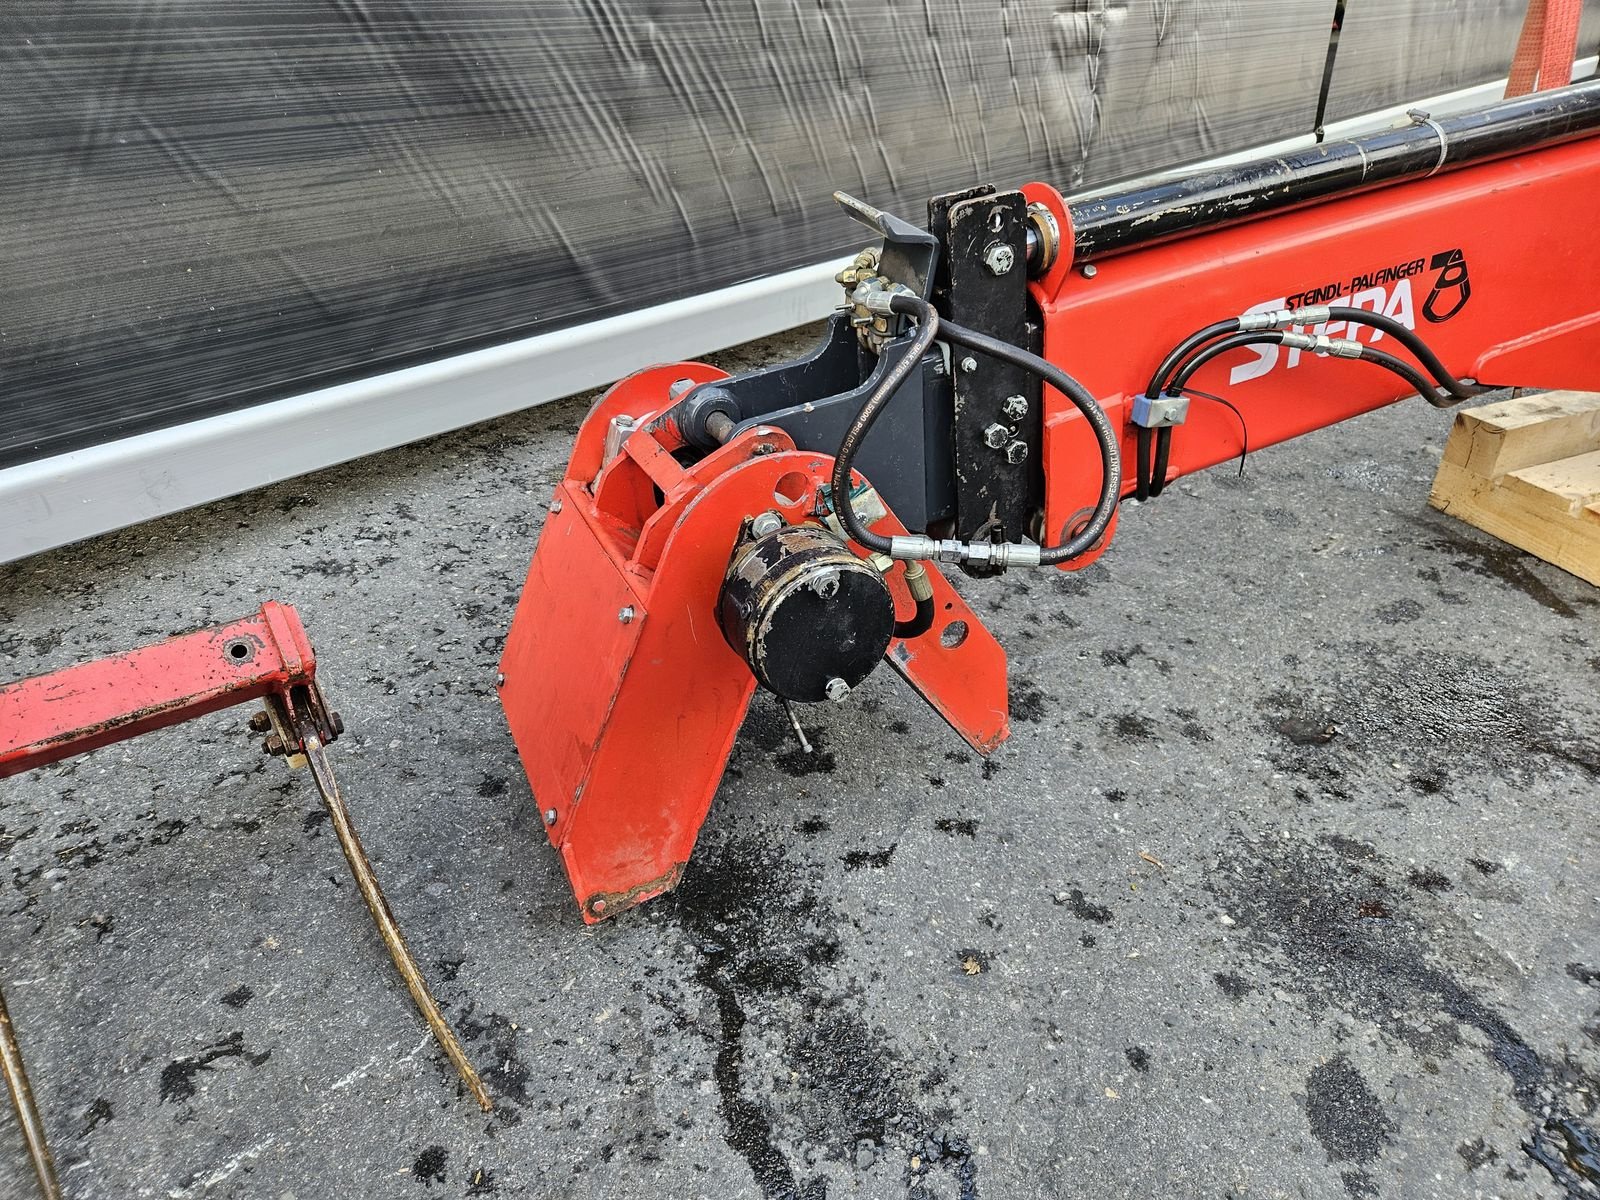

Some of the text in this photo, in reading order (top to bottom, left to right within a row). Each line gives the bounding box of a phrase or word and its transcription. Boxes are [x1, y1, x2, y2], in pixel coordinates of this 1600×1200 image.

[1286, 258, 1425, 311] STEINDL-PALFINGER
[859, 403, 875, 421] 5000
[850, 420, 863, 435] PSI
[1107, 456, 1117, 498] RESISTANT
